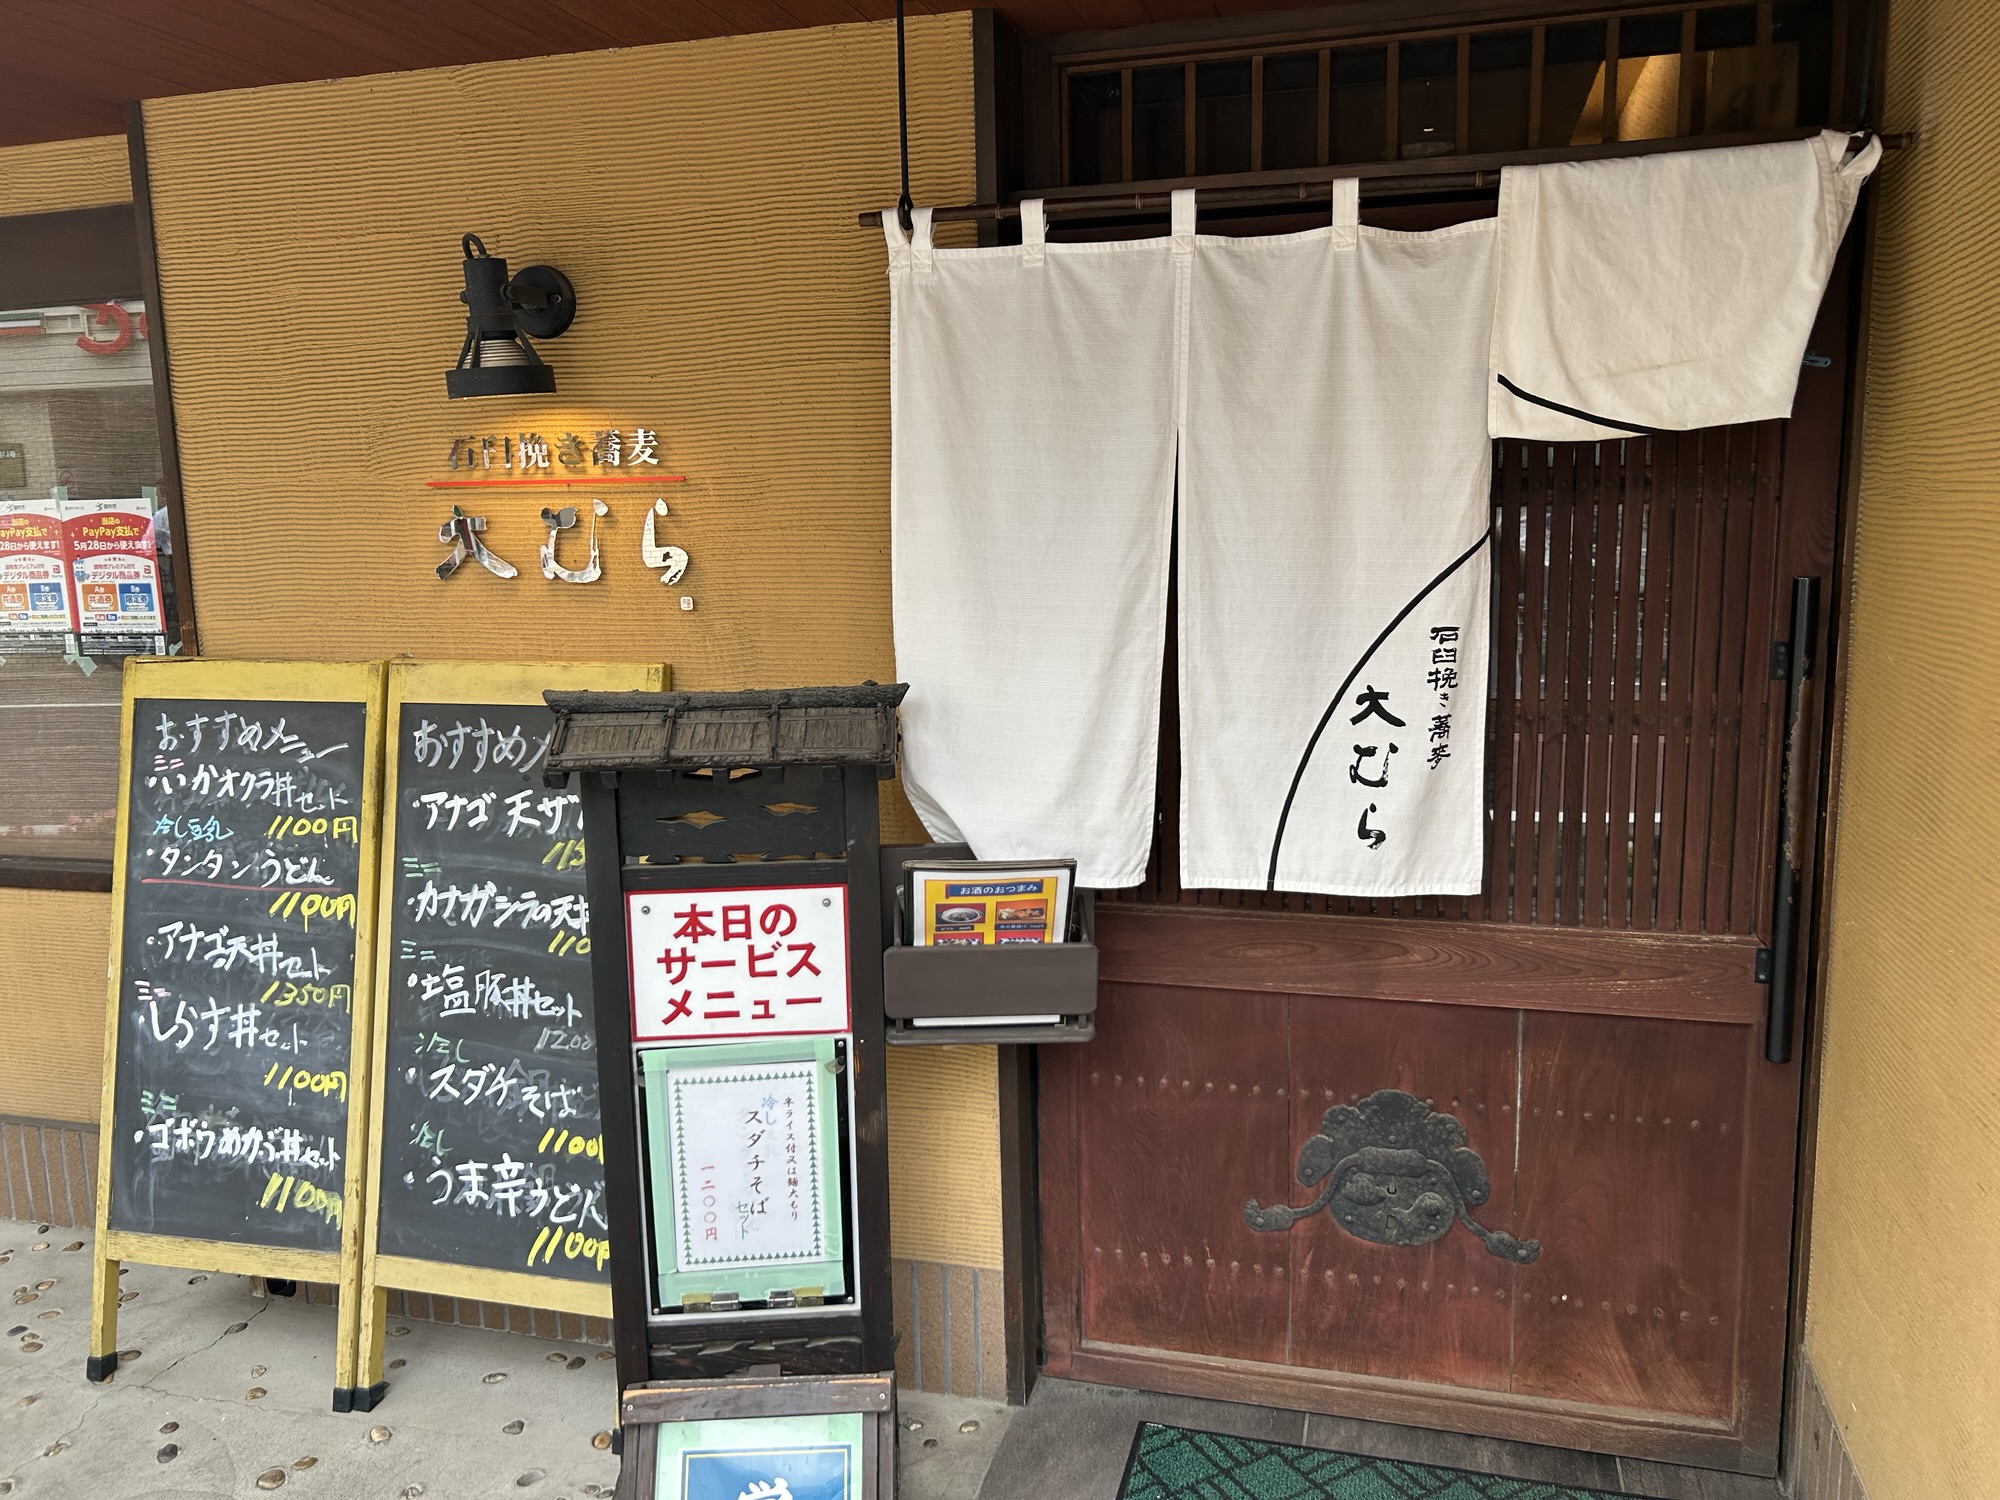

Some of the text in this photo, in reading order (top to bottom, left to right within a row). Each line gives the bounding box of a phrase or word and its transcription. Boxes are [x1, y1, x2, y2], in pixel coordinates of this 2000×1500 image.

[449, 428, 659, 470] 石臼挽き蕎麦
[82, 525, 140, 539] PayPay支払で
[434, 498, 690, 586] 大むら
[154, 710, 349, 764] おすすめメニュー
[1349, 684, 1406, 850] 大むら
[264, 814, 358, 845] 1100円
[420, 789, 584, 838] アナゴ天ザ
[960, 884, 1038, 895] お酒のおつまみ
[268, 891, 357, 929] 1100円
[673, 903, 797, 943] 本日の
[656, 941, 822, 985] サービス
[259, 980, 350, 1014] 1350円
[661, 989, 822, 1025] メニュー
[263, 1062, 348, 1103] 1100円
[429, 1063, 583, 1119] スダチそば
[761, 1094, 779, 1126] 冷し
[538, 1126, 605, 1165] 1100
[745, 1110, 769, 1215] スダチそば
[735, 1200, 752, 1240] セット
